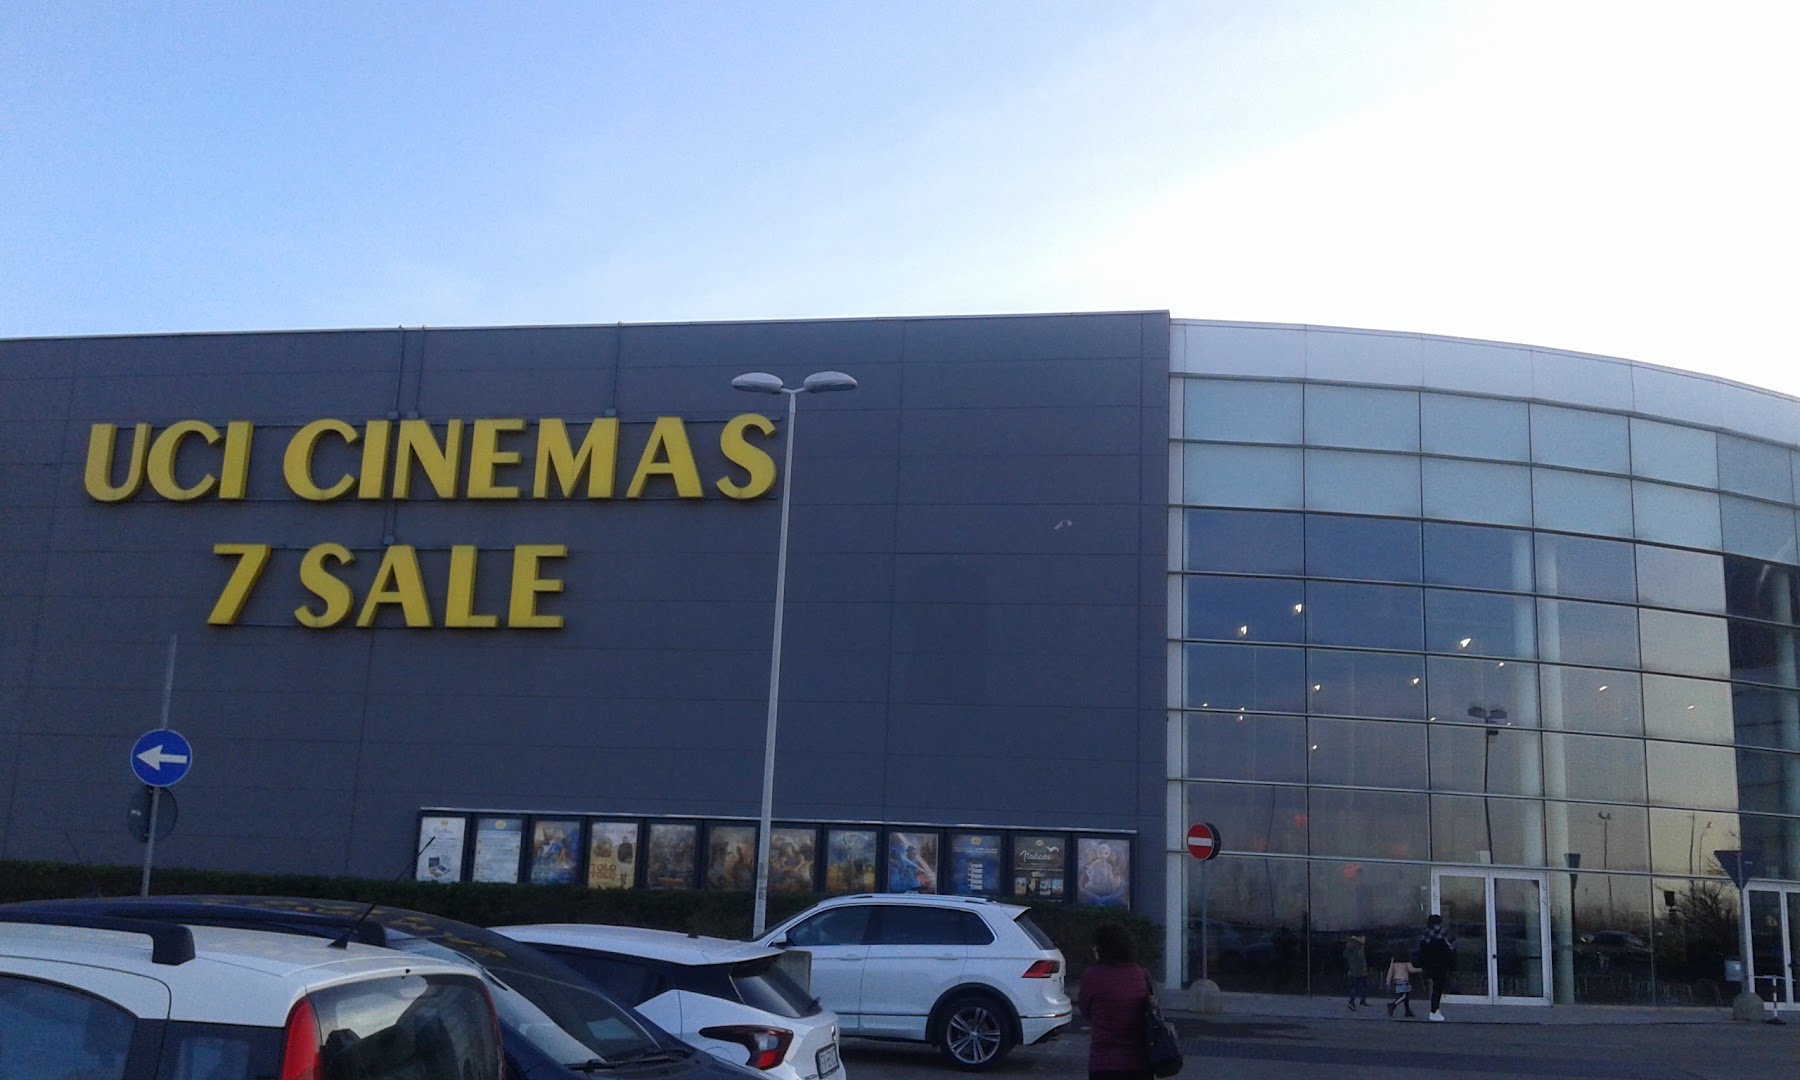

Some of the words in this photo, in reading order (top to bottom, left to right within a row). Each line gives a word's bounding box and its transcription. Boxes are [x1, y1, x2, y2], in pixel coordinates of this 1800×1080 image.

[84, 419, 255, 501] UCI
[282, 413, 778, 500] CINEMAS
[207, 543, 271, 625] 7
[293, 542, 568, 629] SALE
